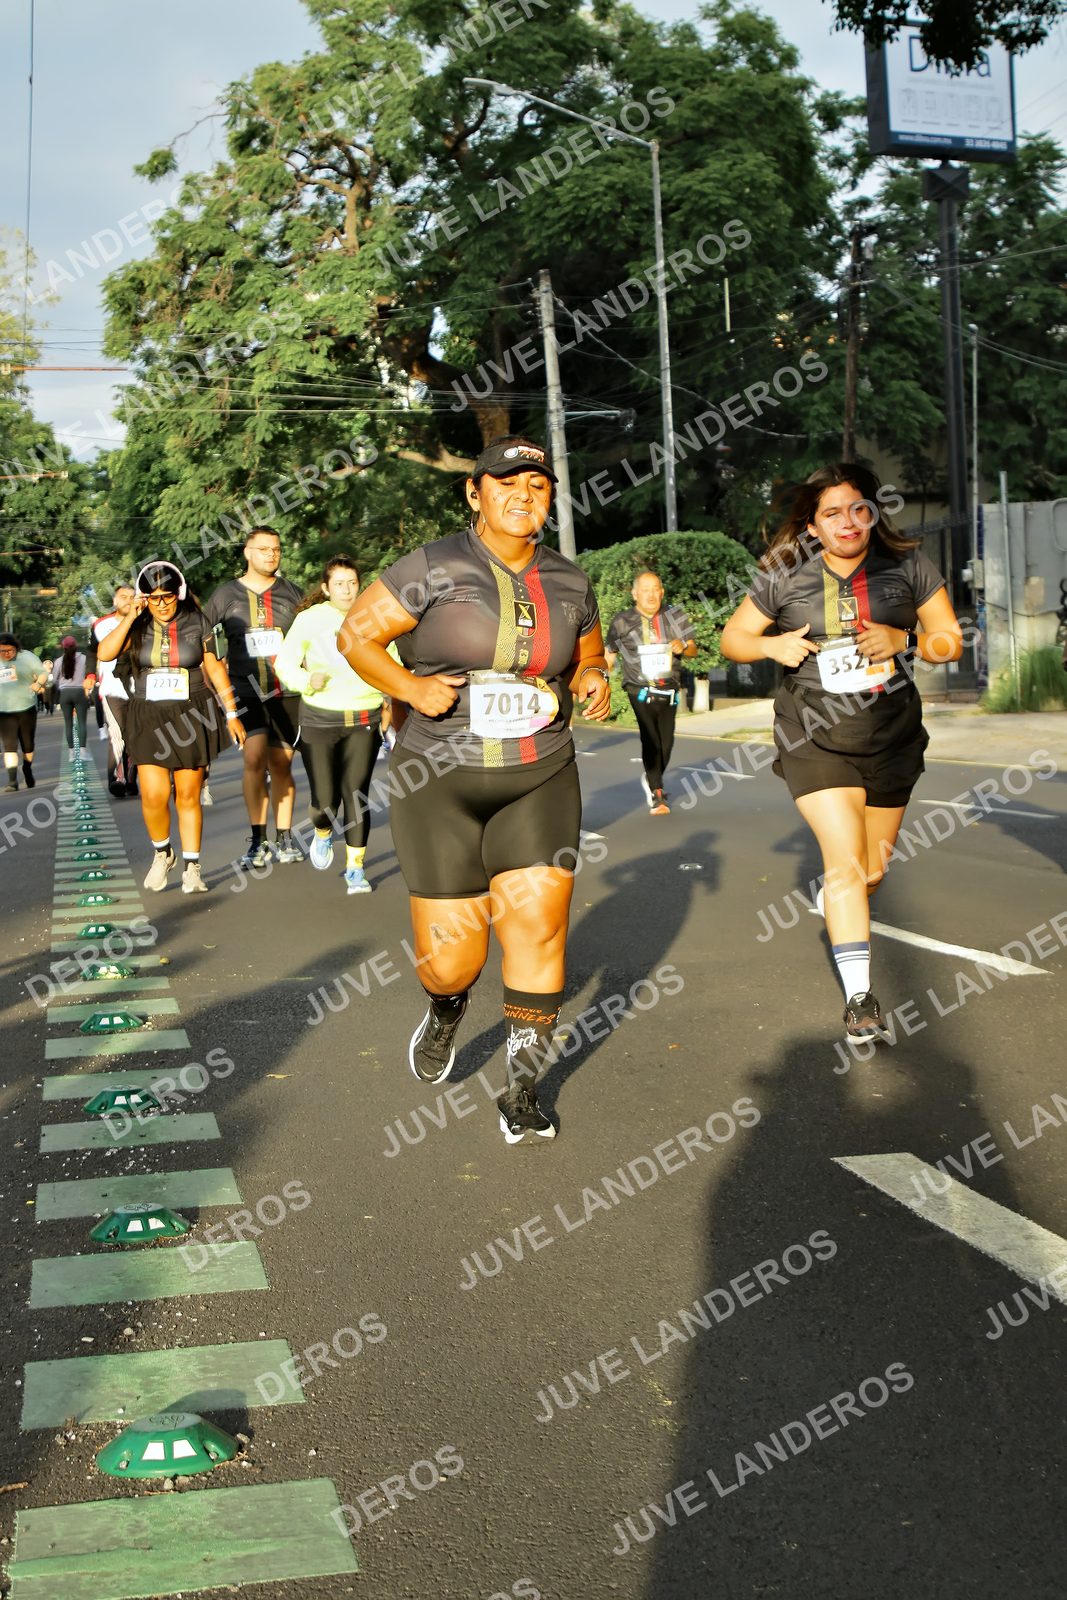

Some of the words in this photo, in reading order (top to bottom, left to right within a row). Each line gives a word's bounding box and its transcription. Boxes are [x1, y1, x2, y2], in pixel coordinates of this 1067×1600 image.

[828, 652, 873, 676] 352
[483, 692, 541, 715] 7014
[503, 1008, 556, 1025] UNNERS
